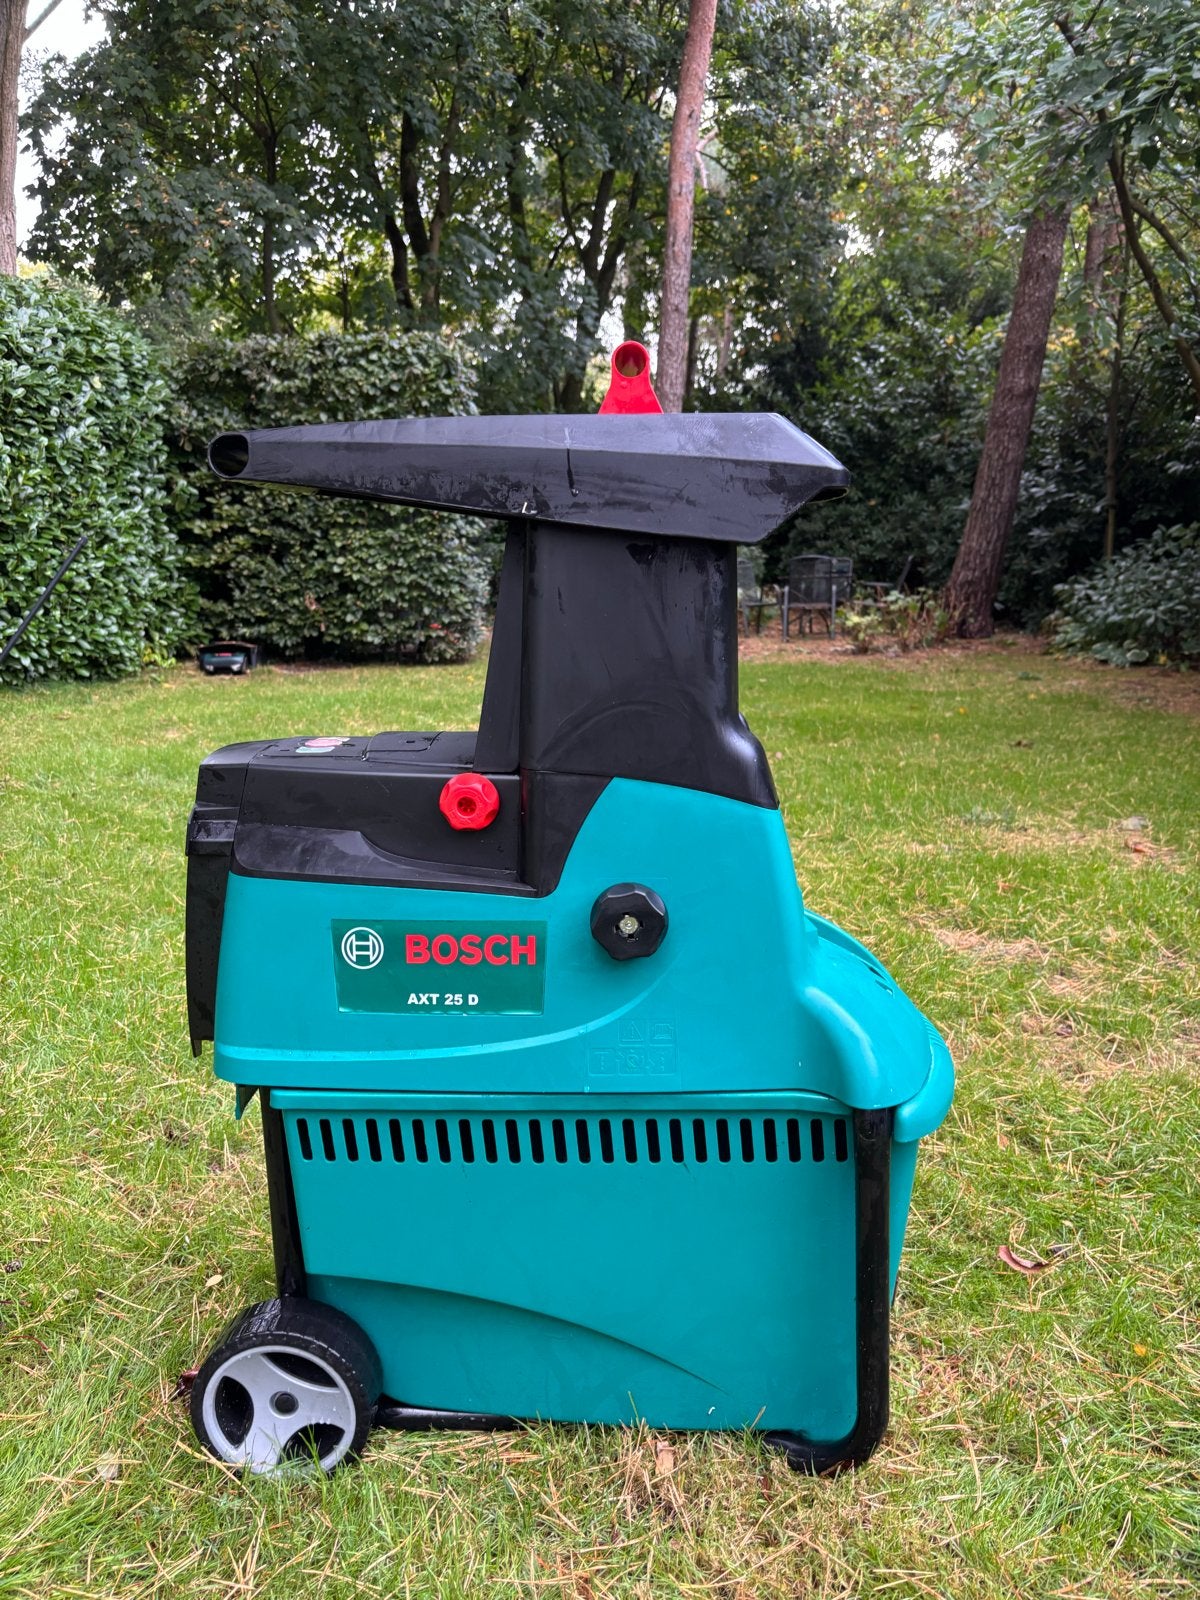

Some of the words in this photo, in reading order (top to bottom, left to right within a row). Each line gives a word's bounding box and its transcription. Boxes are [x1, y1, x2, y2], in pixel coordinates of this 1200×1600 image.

[406, 934, 536, 965] BOSCH
[407, 993, 439, 1005] AXT
[444, 994, 463, 1005] 25
[468, 994, 479, 1005] D
